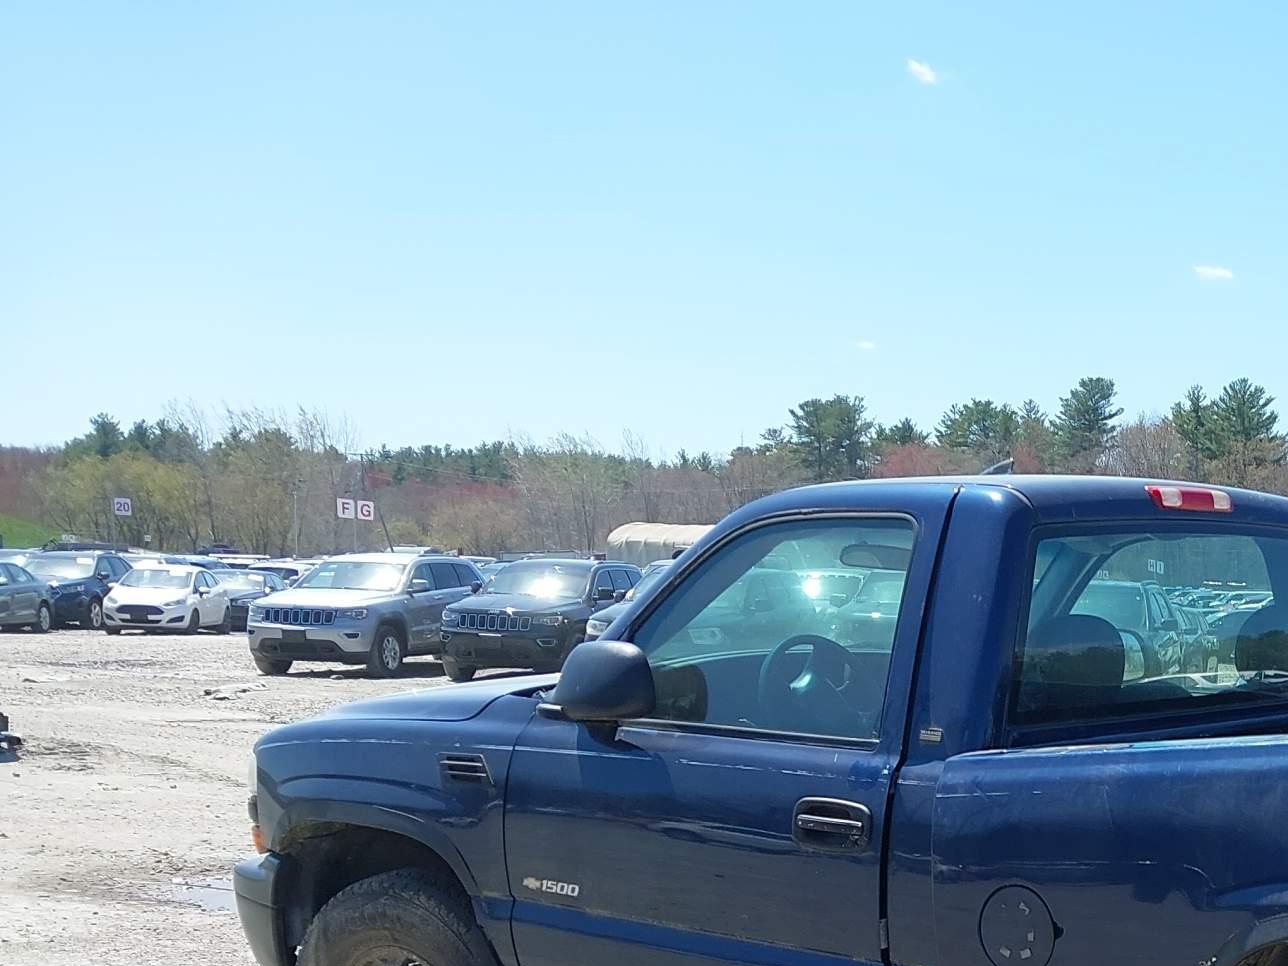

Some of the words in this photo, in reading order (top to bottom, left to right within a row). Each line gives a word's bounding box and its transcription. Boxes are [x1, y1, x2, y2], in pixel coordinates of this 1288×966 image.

[116, 501, 130, 513] 20
[341, 501, 351, 515] F
[360, 503, 371, 518] G
[541, 879, 580, 897] 1500
